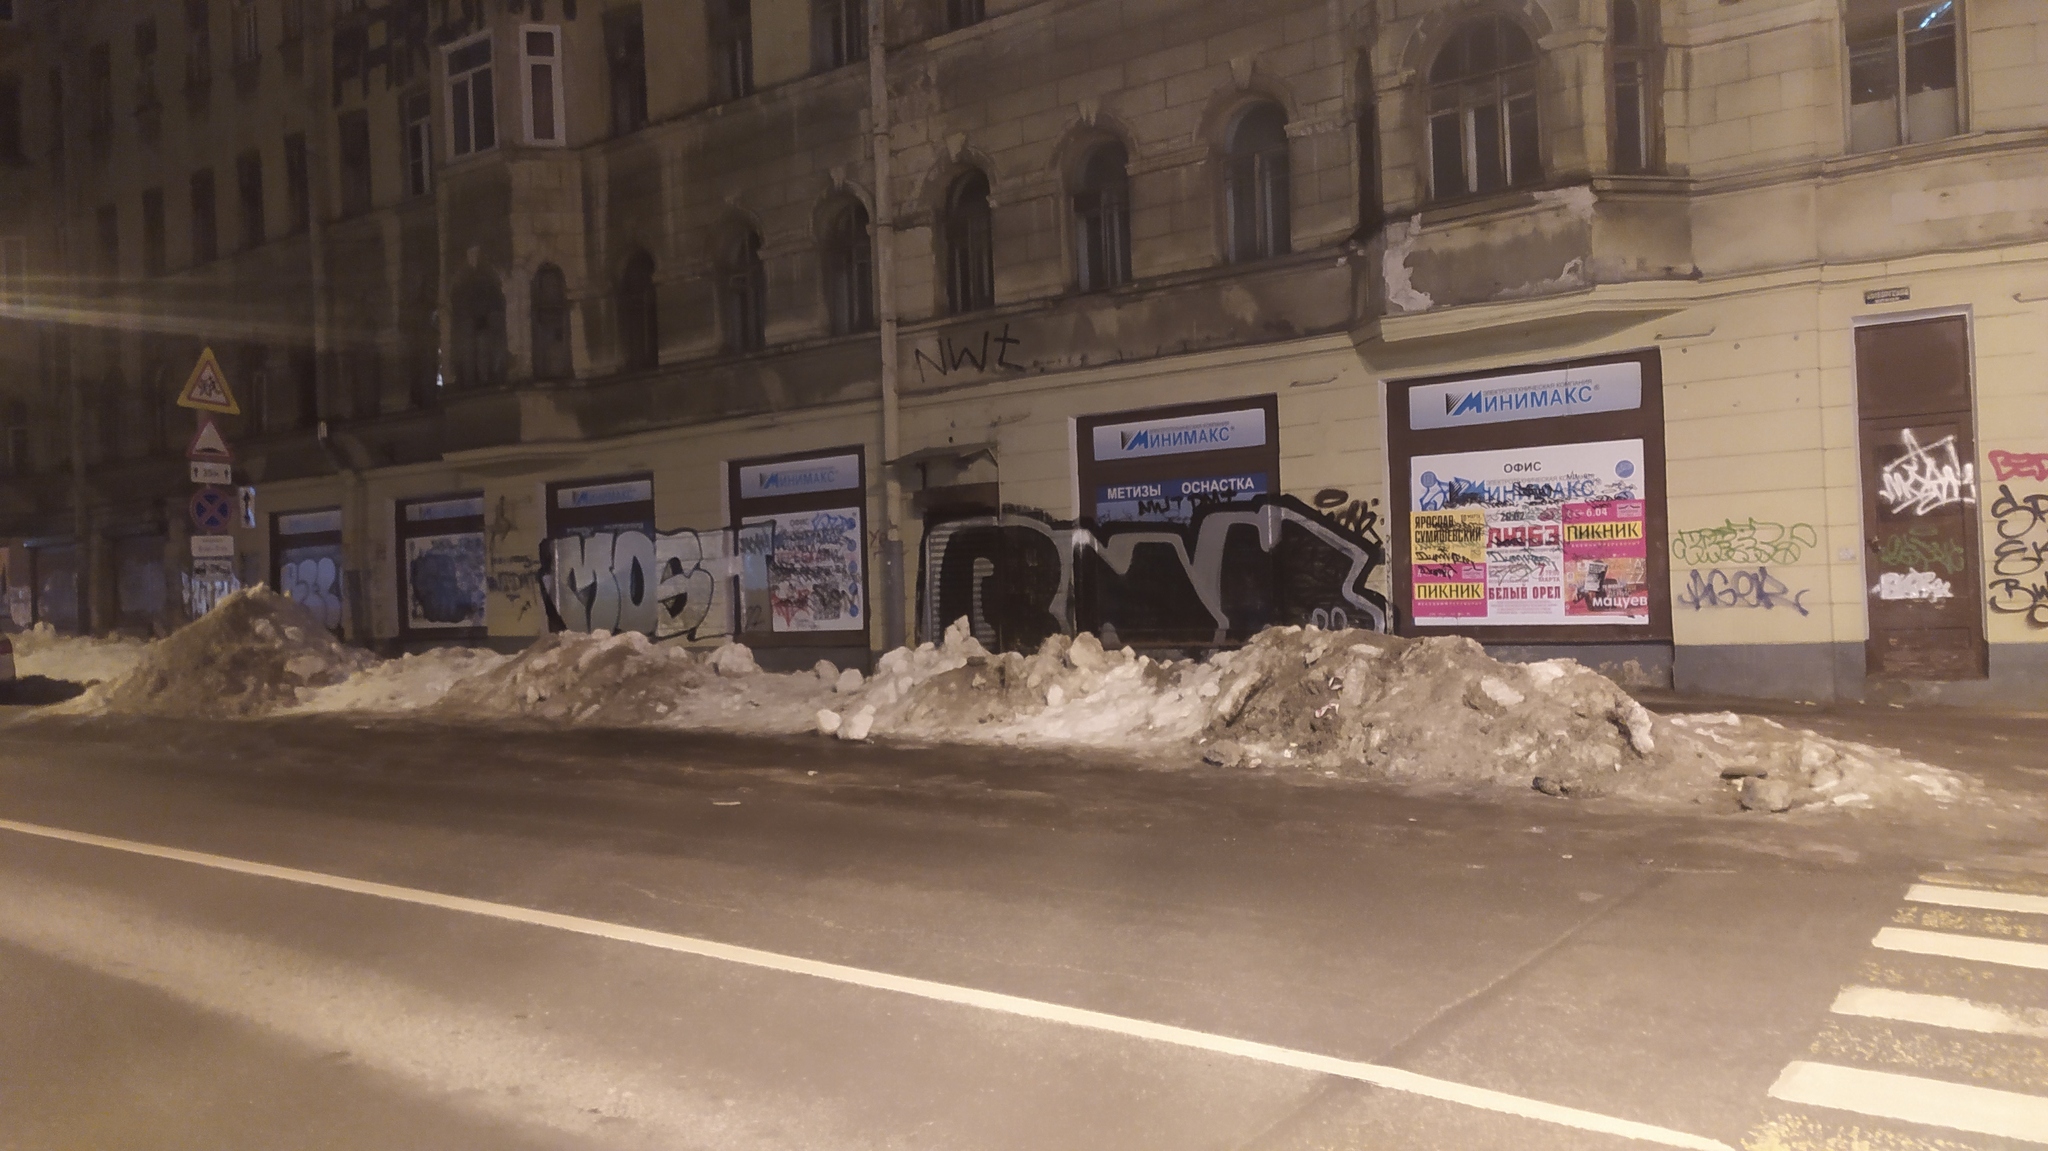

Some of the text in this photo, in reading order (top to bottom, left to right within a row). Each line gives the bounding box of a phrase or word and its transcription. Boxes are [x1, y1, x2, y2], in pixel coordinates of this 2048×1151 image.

[1484, 379, 1592, 395] ЭЛЕКТРОТЕХНИЧЕСКАЯ КОМПАНИЯ
[1503, 461, 1542, 474] ОФИС
[1107, 477, 1254, 500] МЕТИЗЫ ОСНАСТКА
[1415, 515, 1454, 529] ЯРОСЛАВ
[1567, 523, 1639, 540] ПИКНИК
[1417, 584, 1481, 599] ПИКНИК
[1488, 583, 1561, 600] БЕЛЫЙ ОРЕЛ
